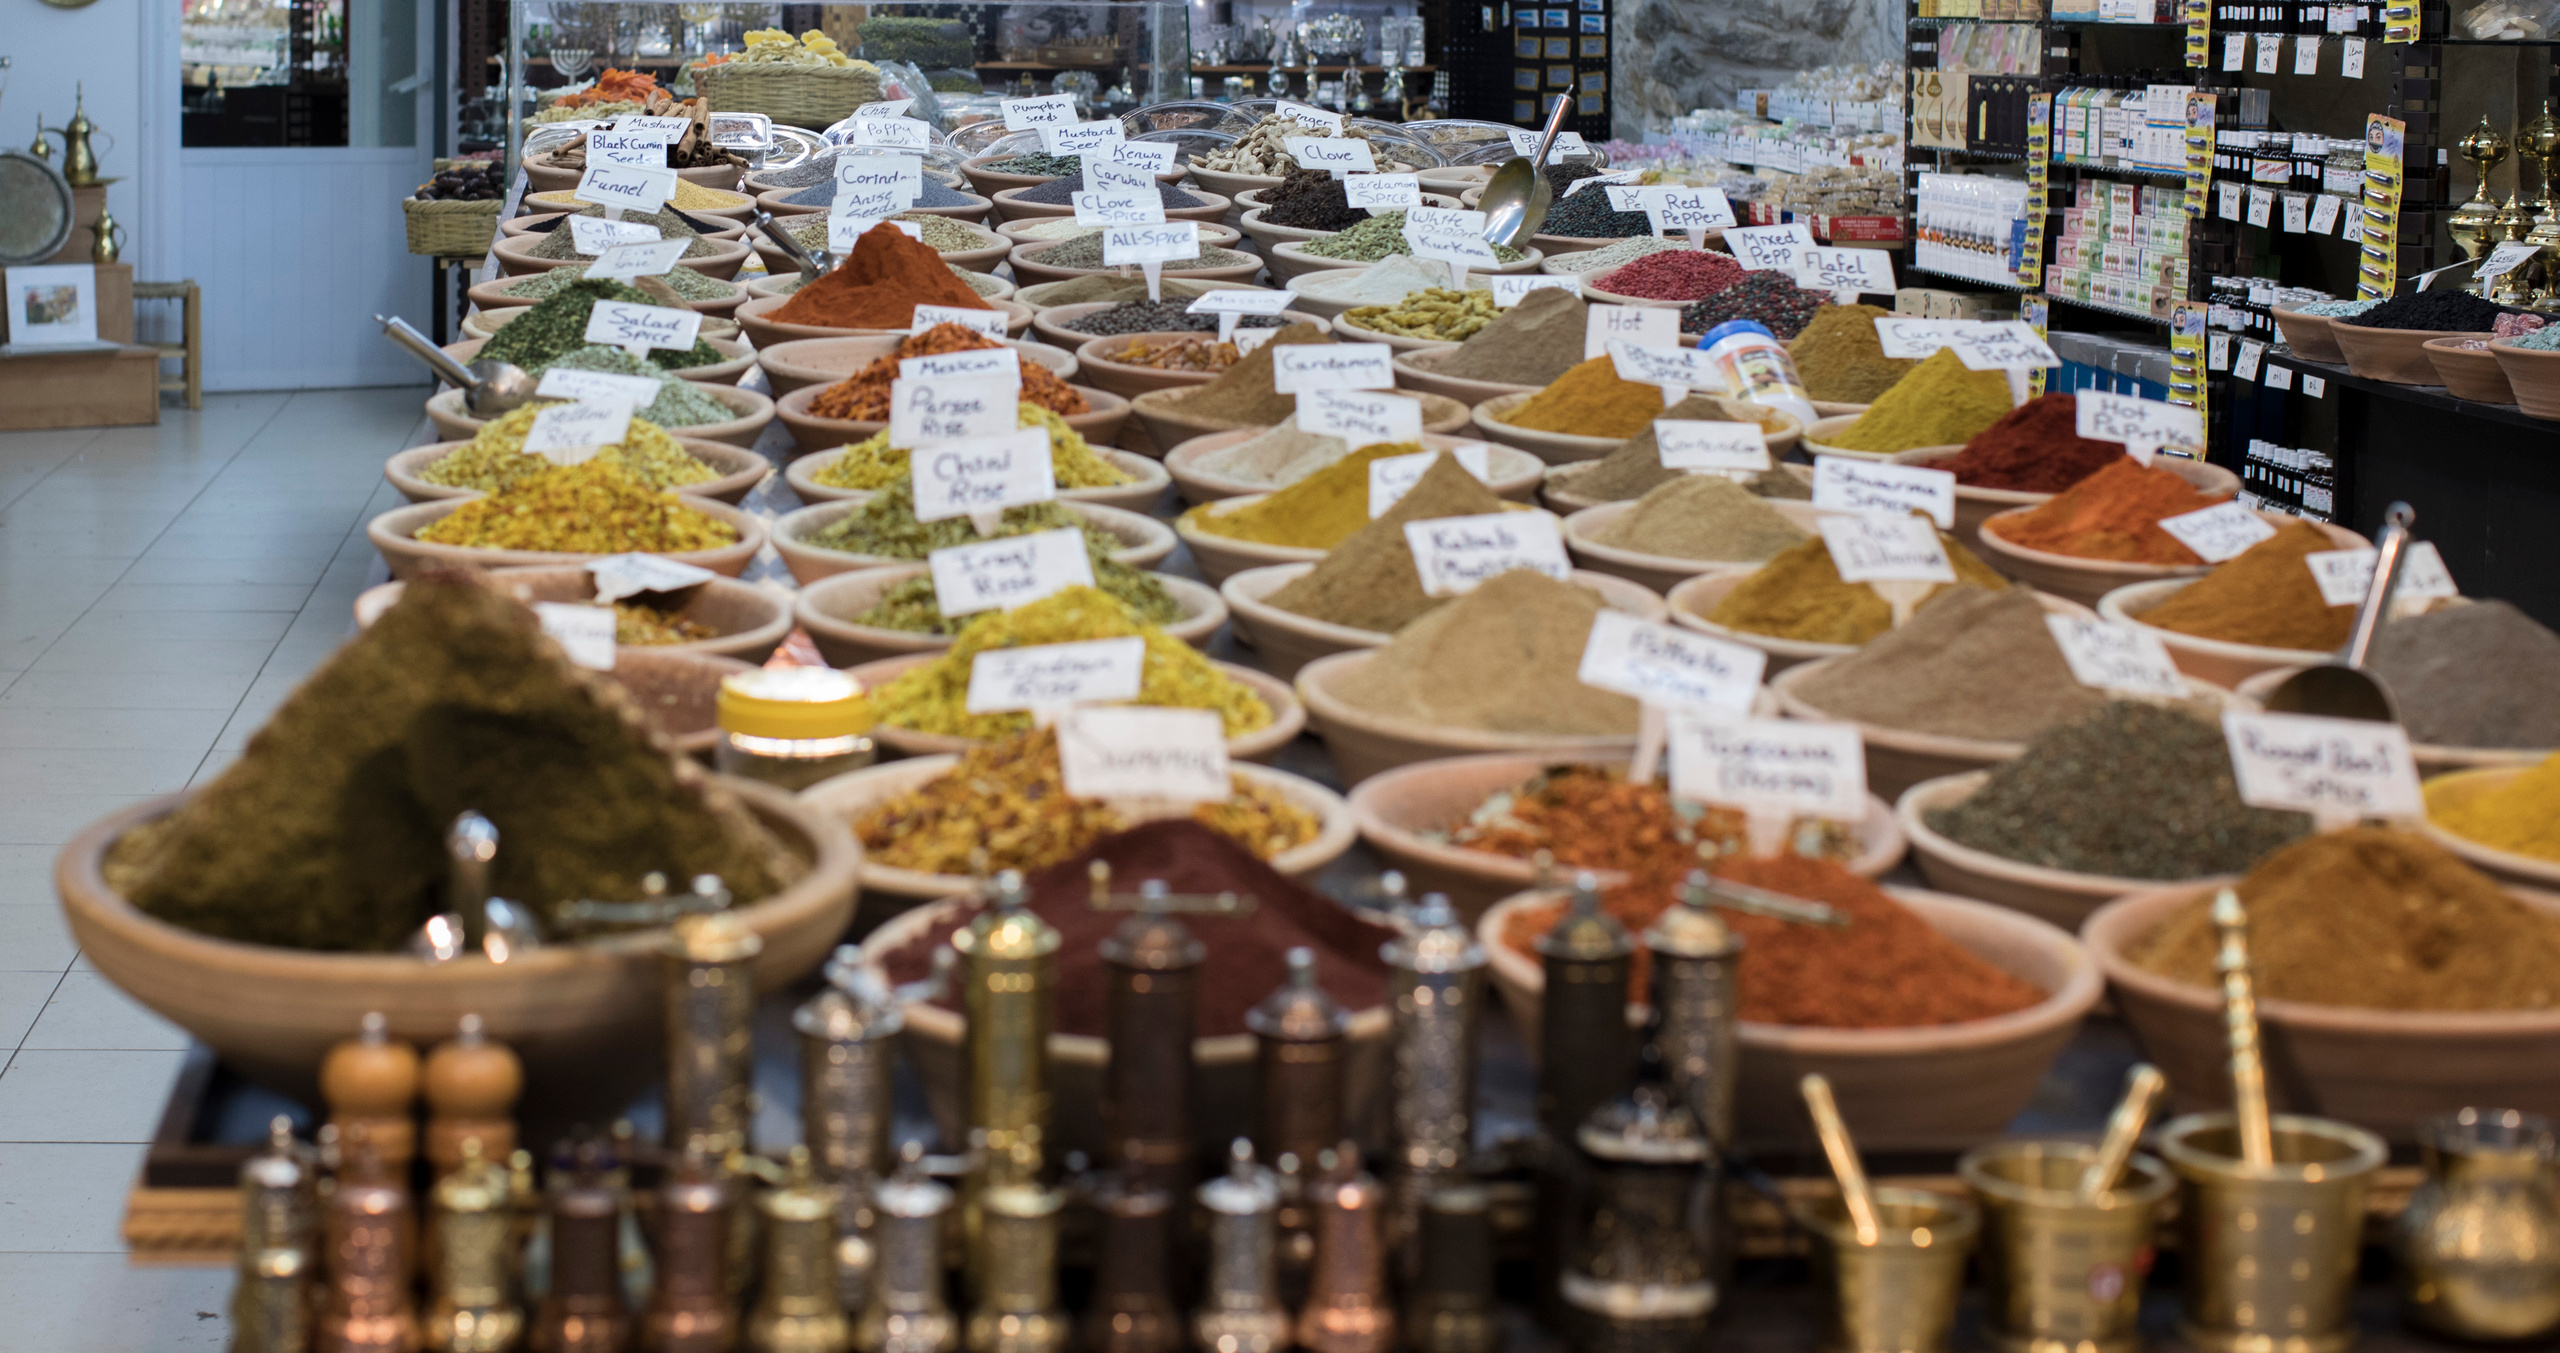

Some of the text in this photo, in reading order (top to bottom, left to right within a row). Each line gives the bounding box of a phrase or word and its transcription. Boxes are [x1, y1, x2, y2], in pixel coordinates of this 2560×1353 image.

[1013, 101, 1066, 114] Pumpkin
[627, 118, 682, 130] Mustard
[1026, 114, 1057, 123] seeds
[1059, 126, 1116, 139] Mustard
[630, 138, 663, 150] Cumin
[1112, 144, 1163, 160] Kenwa
[607, 152, 653, 165] Seeds
[586, 168, 648, 197] Funnel
[1092, 163, 1146, 188] Carway
[849, 190, 894, 208] Anise
[1665, 193, 1705, 210] Red
[845, 200, 898, 218] Seeds
[1411, 211, 1463, 228] White
[607, 306, 682, 333] Salad
[1606, 308, 1644, 331] Hot
[2101, 396, 2149, 421] Hot
